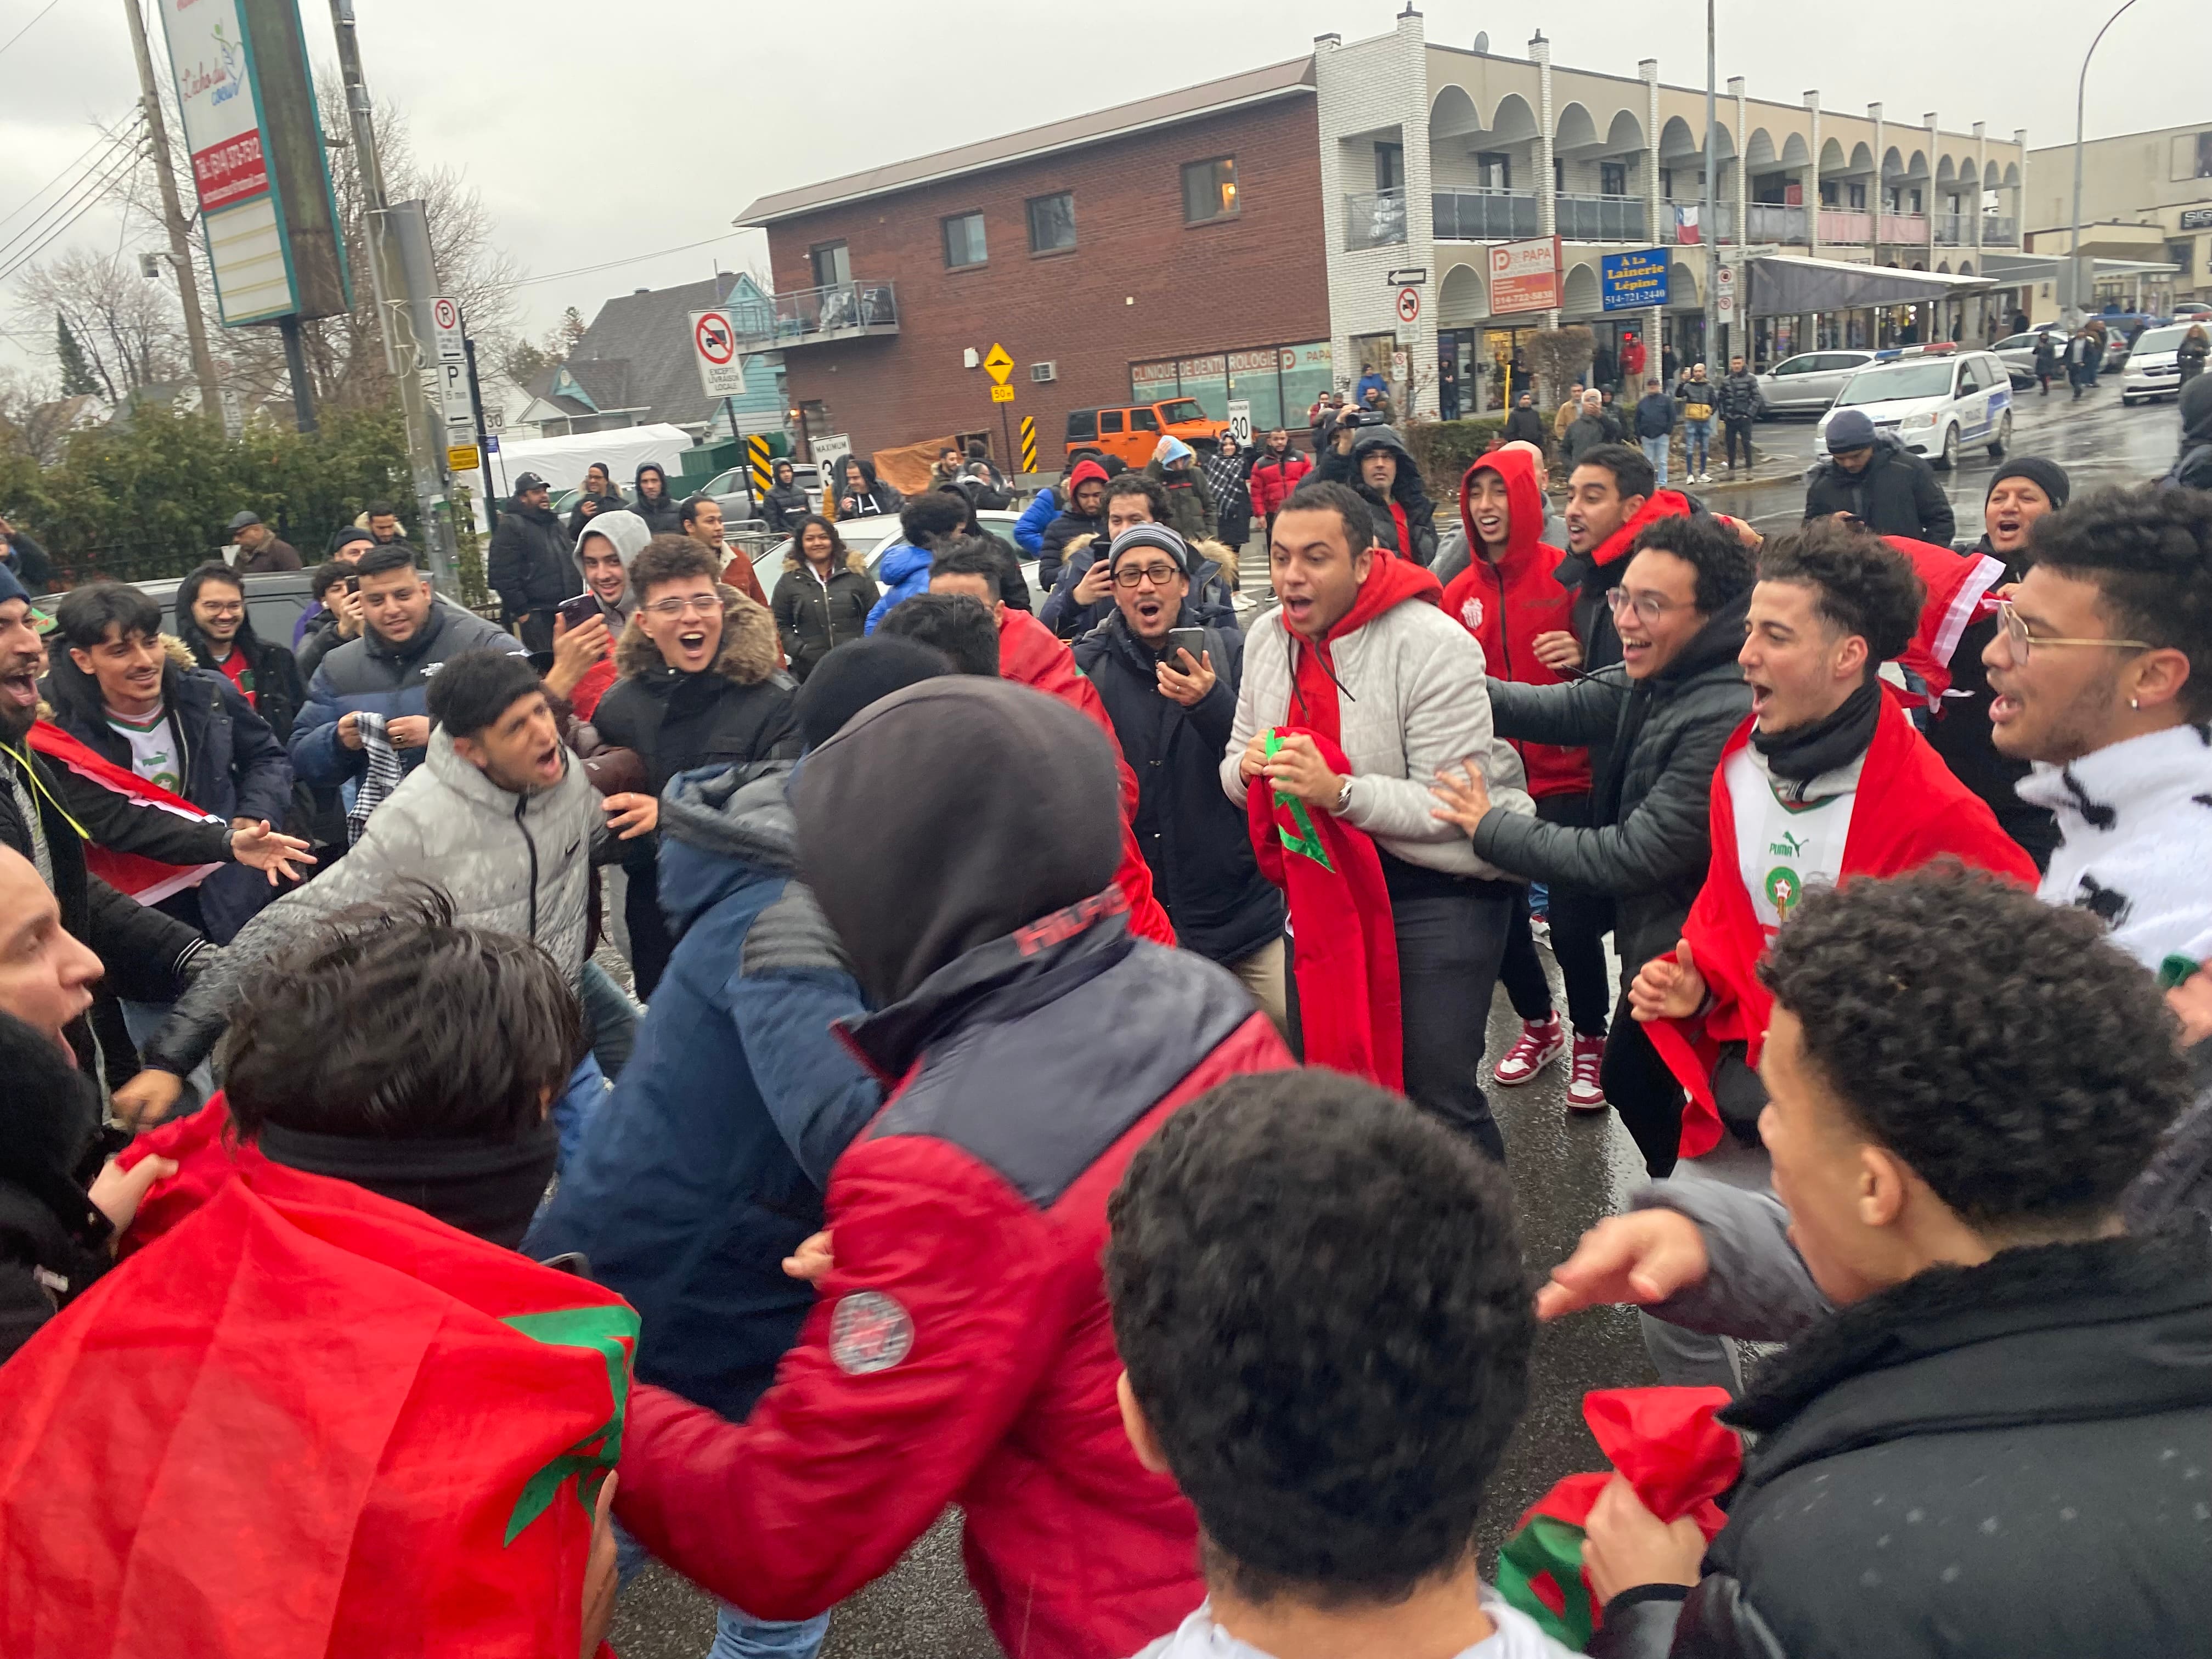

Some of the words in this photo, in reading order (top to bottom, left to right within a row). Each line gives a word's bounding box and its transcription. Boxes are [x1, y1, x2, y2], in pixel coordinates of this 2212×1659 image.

[1522, 247, 1551, 261] PAPA
[1607, 264, 1664, 279] Lainerie
[1614, 279, 1658, 291] Lépine
[1306, 349, 1331, 362] PAPA
[1132, 362, 1177, 381] CLINIQUE
[1179, 361, 1192, 376] DE
[1193, 350, 1278, 375] DENTUROLOGIE
[447, 365, 459, 387] P
[708, 375, 740, 383] LIVRAISON
[715, 382, 737, 391] LOCALE
[994, 389, 1005, 398] 50
[486, 413, 503, 428] 30
[1232, 416, 1248, 439] 30
[815, 441, 847, 453] MAXIMUM
[1769, 842, 1793, 857] PUMA
